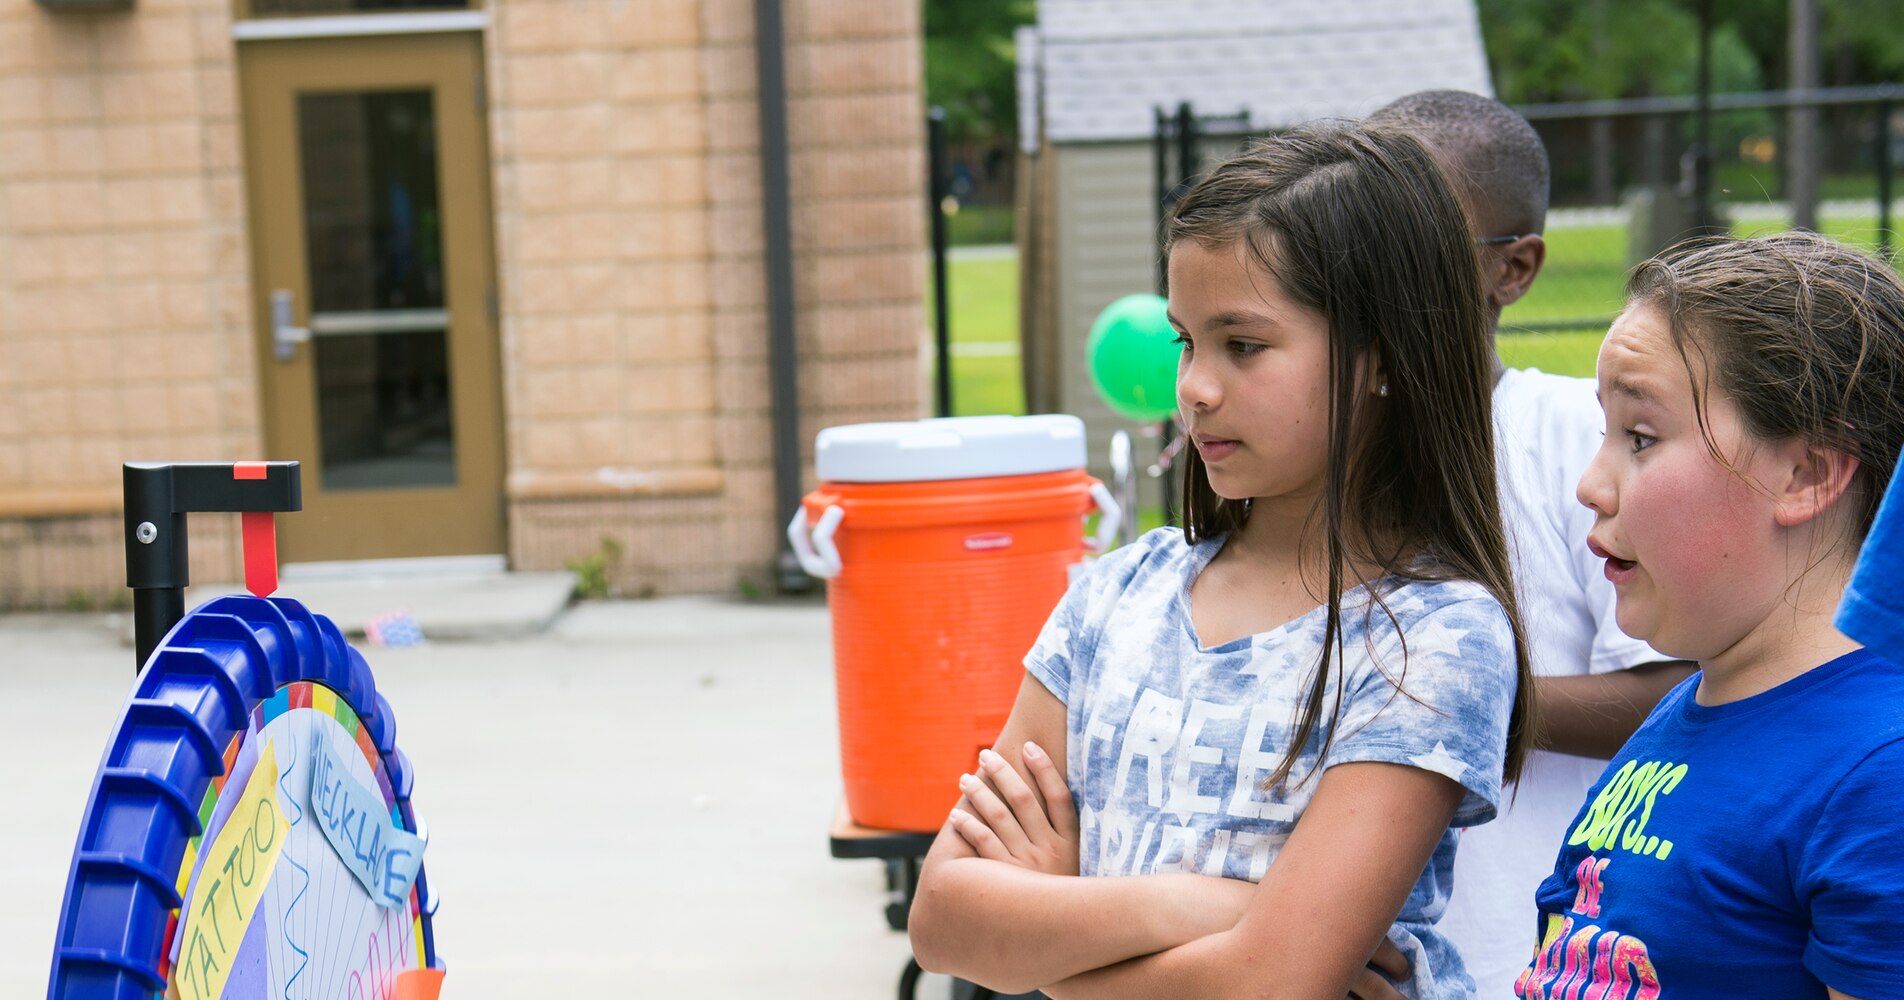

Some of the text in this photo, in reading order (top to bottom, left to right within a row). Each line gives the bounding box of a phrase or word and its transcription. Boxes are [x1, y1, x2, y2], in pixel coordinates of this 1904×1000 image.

[1083, 676, 1310, 822] FREE
[315, 746, 412, 901] NECKLACE
[1571, 855, 1611, 919] BE
